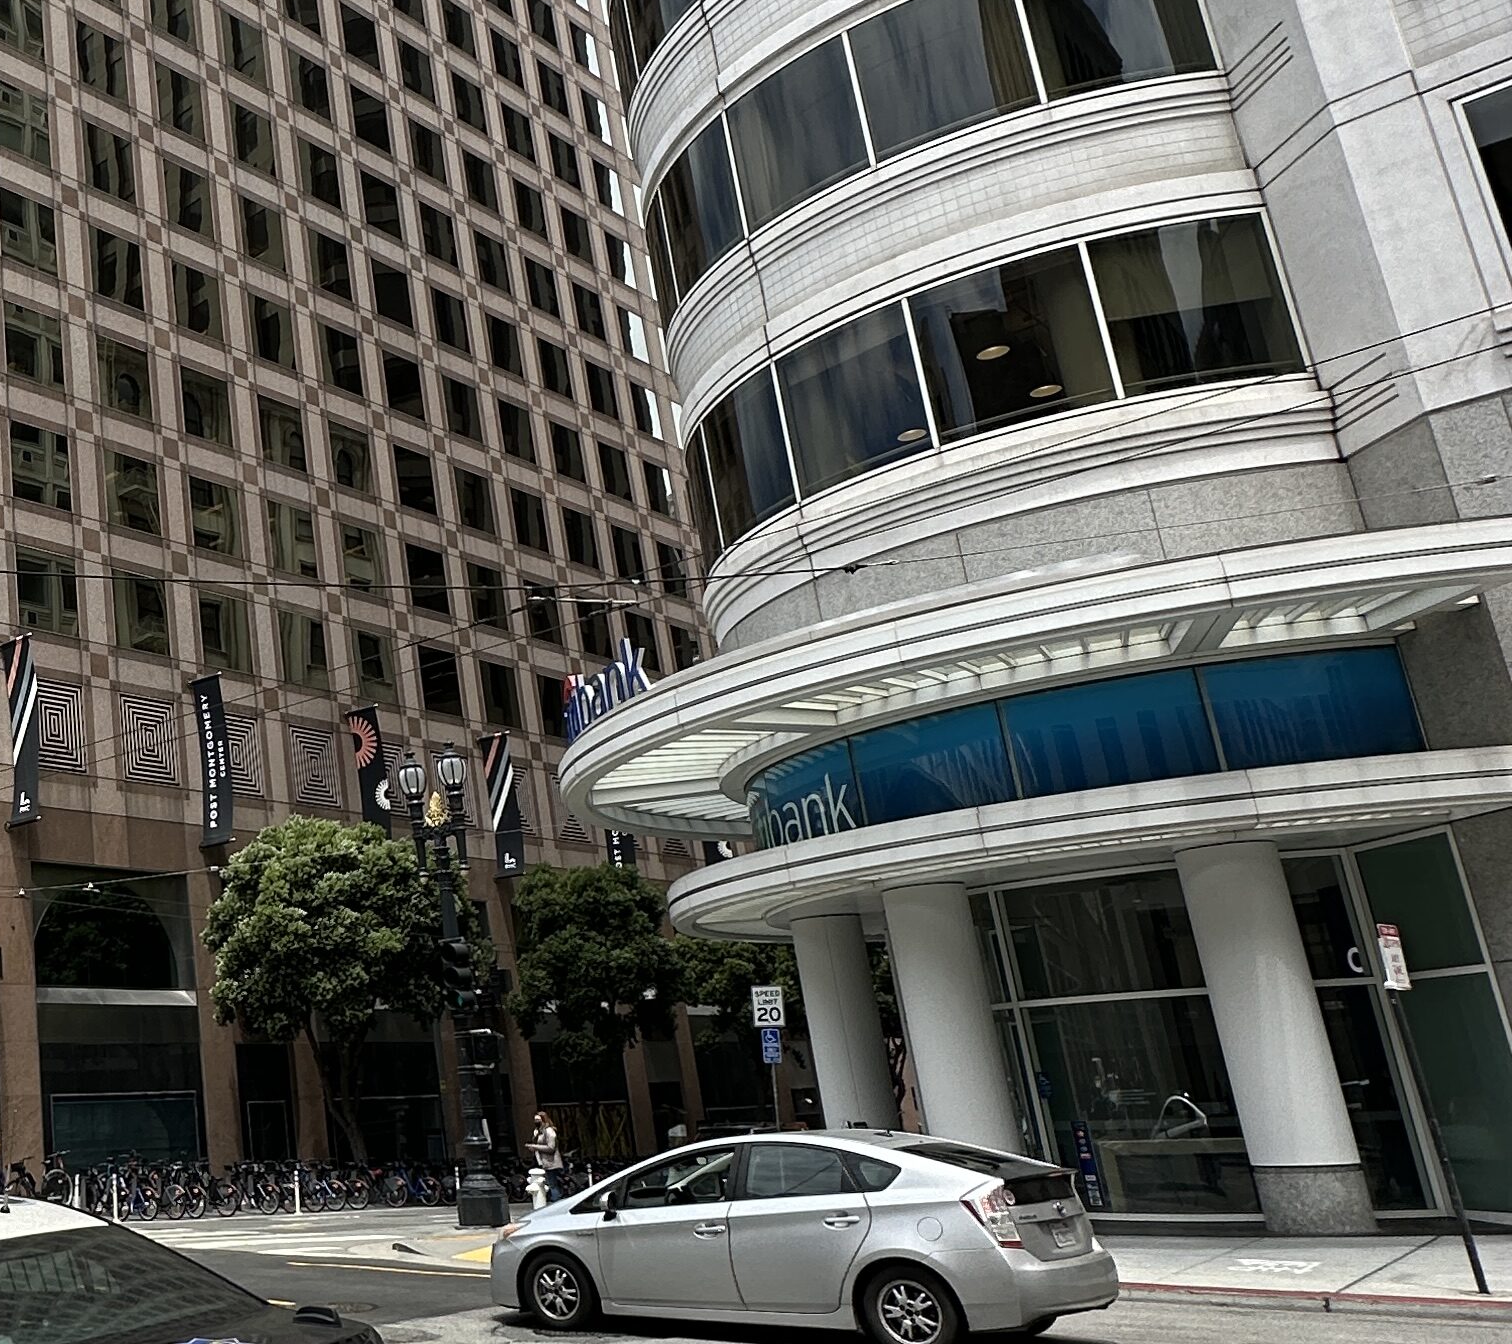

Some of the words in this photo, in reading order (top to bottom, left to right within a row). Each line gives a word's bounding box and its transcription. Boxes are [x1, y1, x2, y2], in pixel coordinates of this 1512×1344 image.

[200, 694, 218, 789] MONTGOMERY
[217, 740, 226, 778] CENTER
[209, 794, 219, 829] POST
[754, 990, 781, 998] SPEED
[756, 1007, 781, 1022] 20
